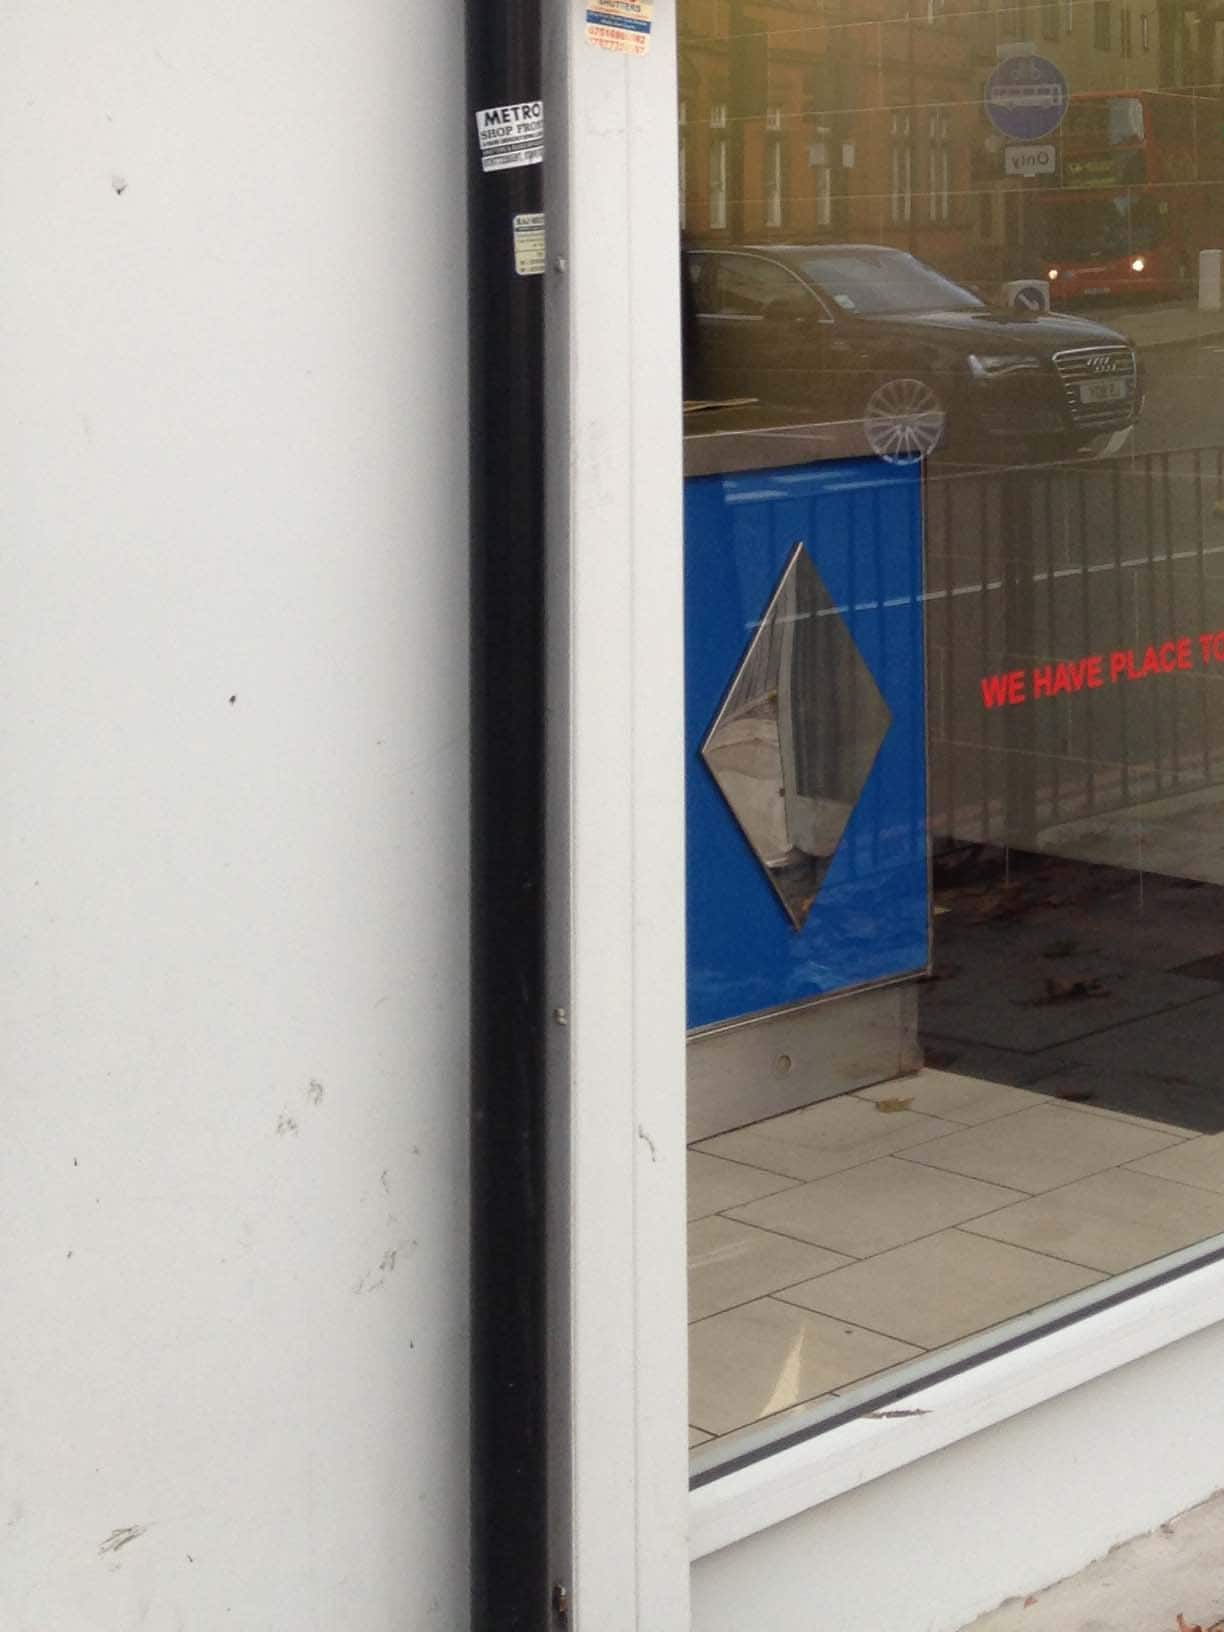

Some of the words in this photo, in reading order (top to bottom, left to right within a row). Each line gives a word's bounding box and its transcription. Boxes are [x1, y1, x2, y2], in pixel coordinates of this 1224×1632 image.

[485, 103, 541, 126] METRO
[481, 127, 512, 140] SHOP
[981, 671, 1025, 709] WE
[1033, 657, 1104, 699] HAVE
[1110, 638, 1193, 684] PLACE
